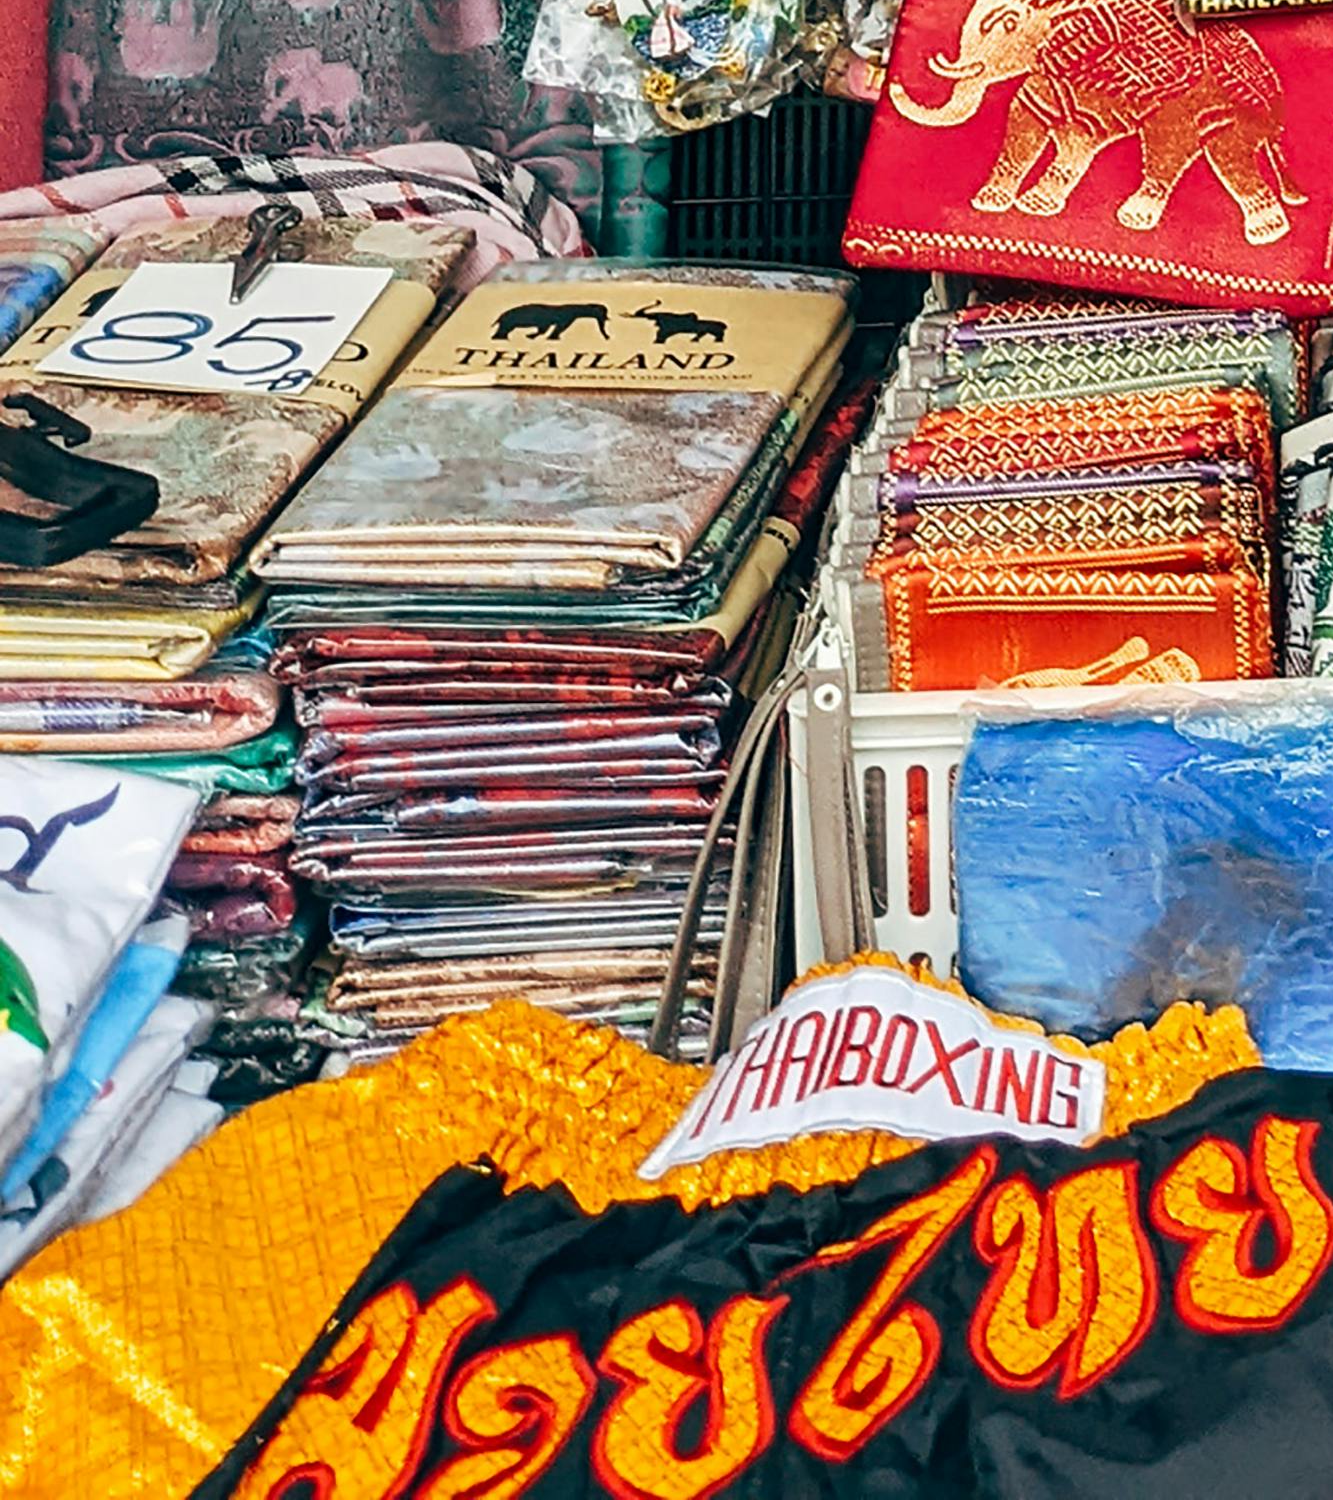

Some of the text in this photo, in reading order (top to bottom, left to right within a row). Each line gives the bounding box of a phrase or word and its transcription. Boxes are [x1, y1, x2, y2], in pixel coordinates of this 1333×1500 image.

[69, 310, 336, 375] 85
[455, 347, 738, 370] THAILAND
[690, 1003, 1082, 1136] THAIBOXING
